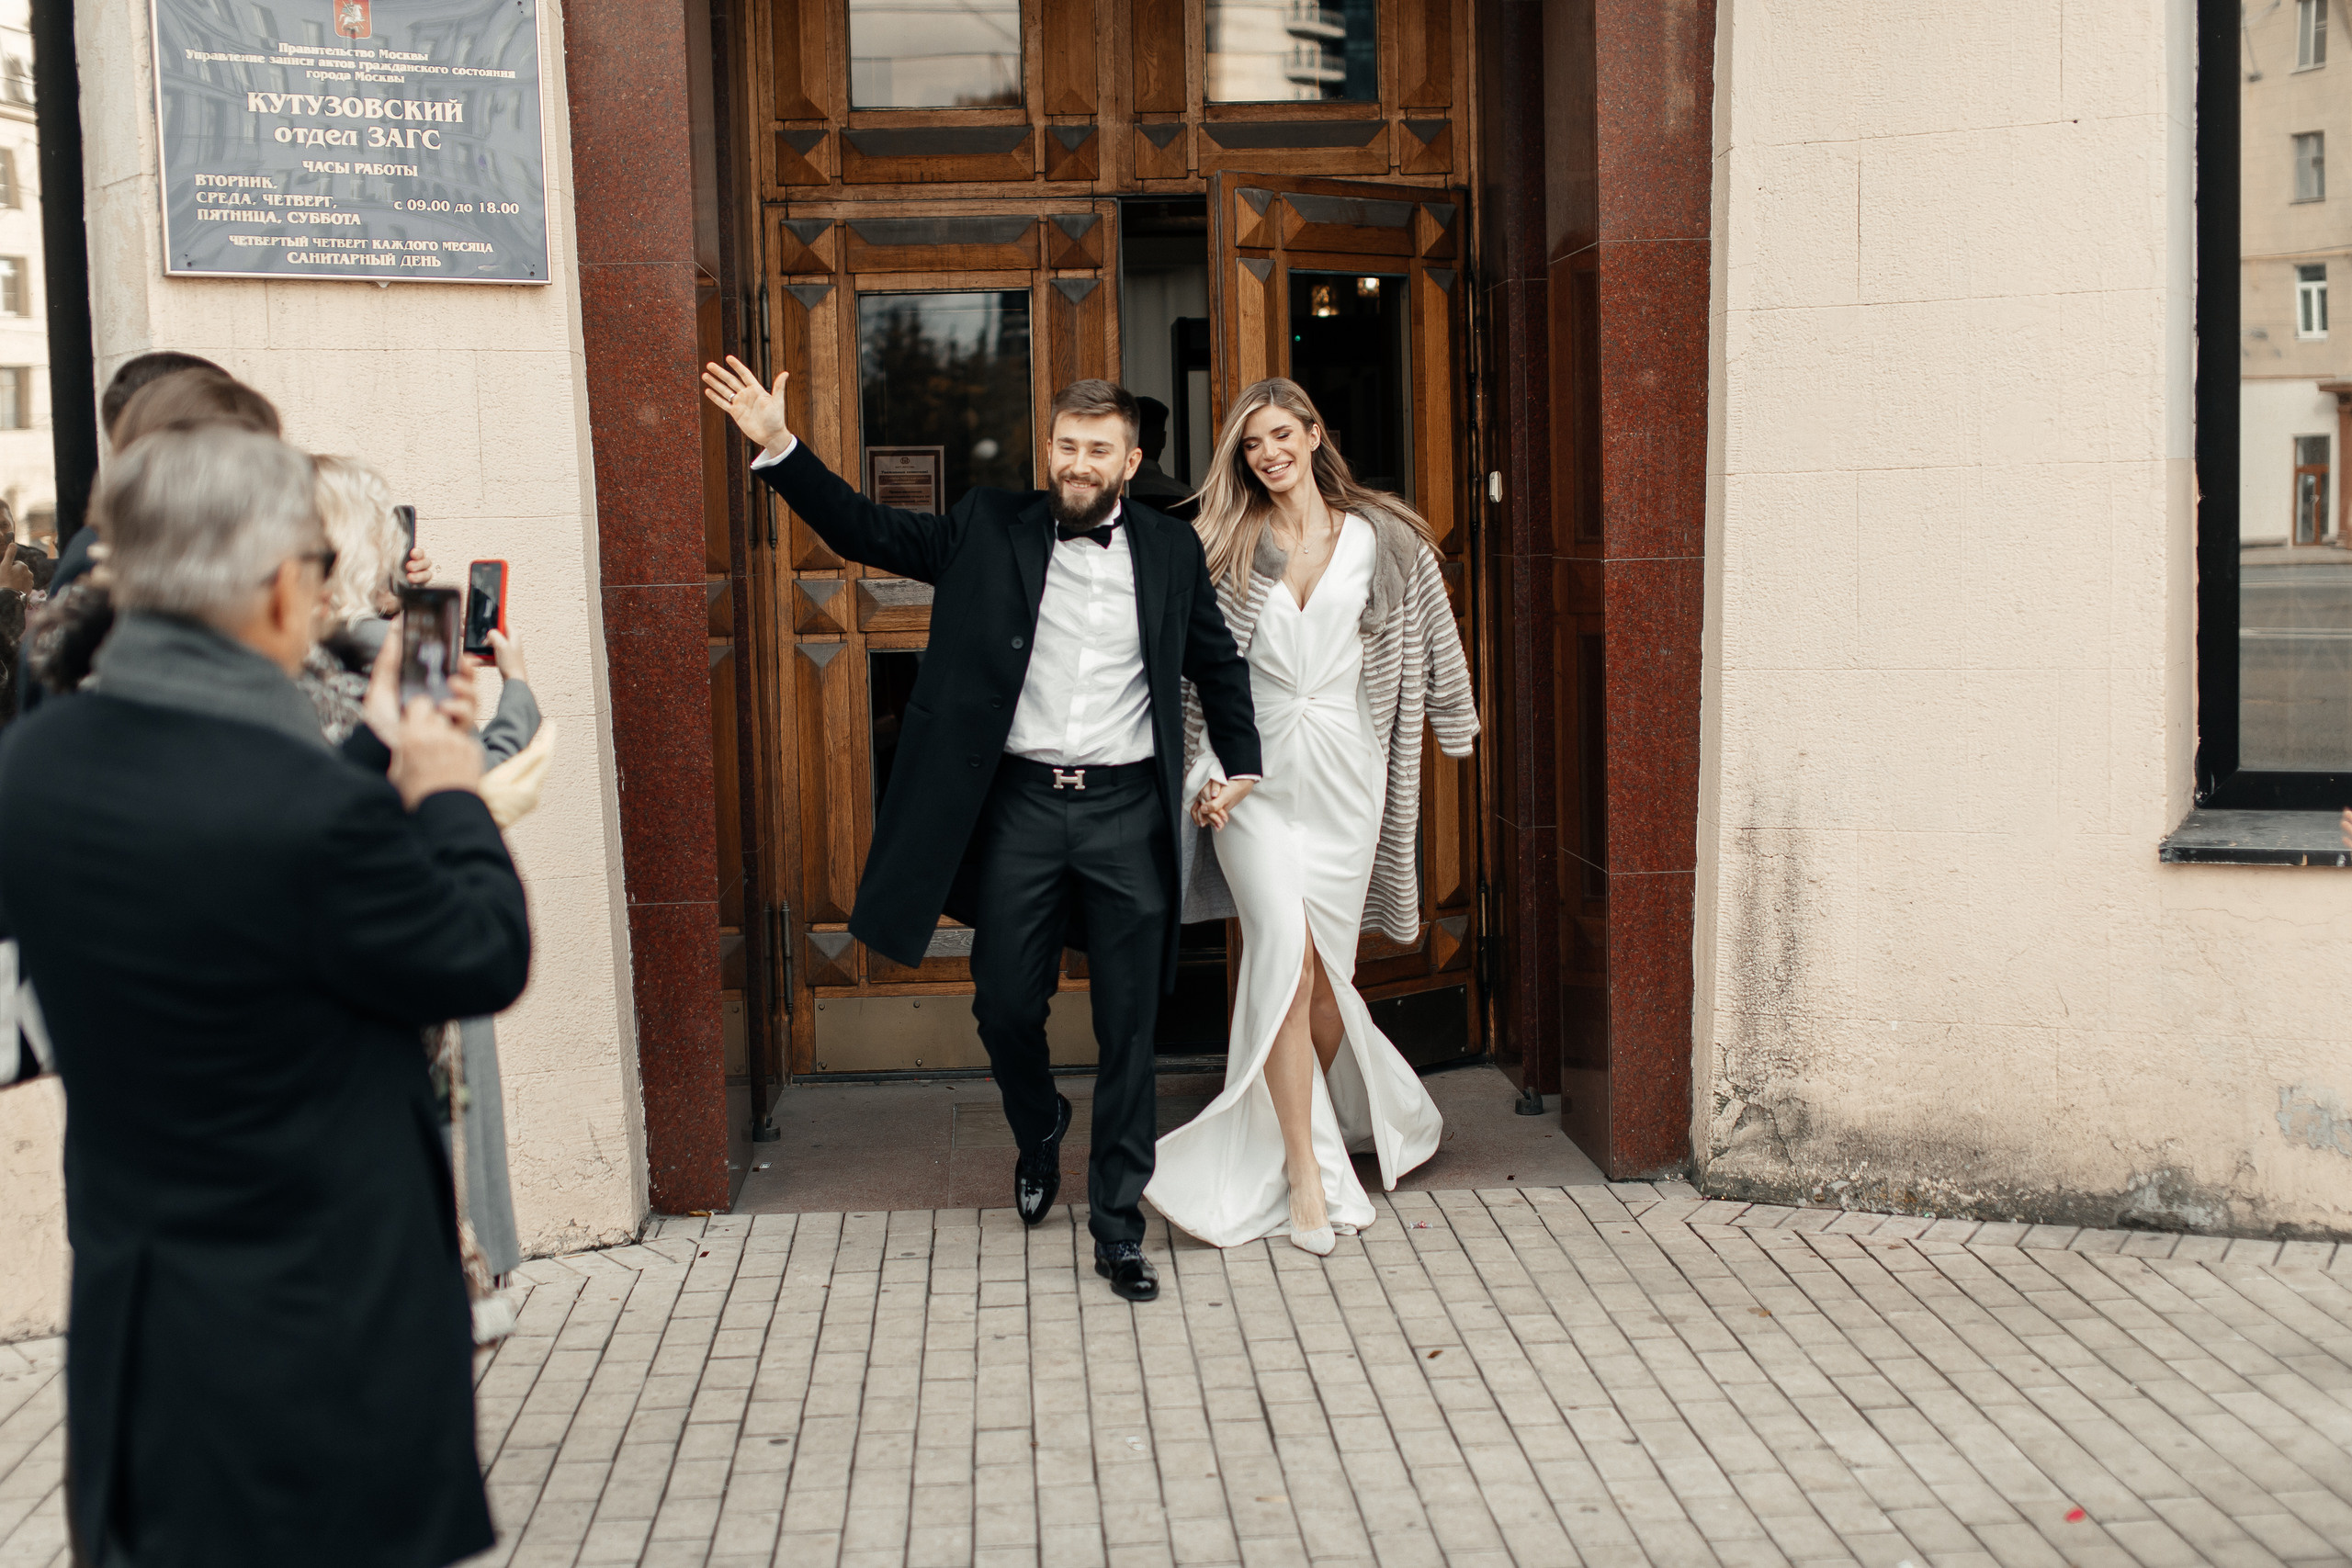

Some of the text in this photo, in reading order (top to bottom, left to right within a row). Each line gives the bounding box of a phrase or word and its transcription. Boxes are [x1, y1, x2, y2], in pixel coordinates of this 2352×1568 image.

[278, 42, 429, 62] Правительство Москвы
[186, 49, 516, 79] Управление записи актов гражданского состояния
[306, 70, 405, 84] города Москвы
[247, 92, 464, 123] КУТУЗОВСКИЙ
[274, 126, 442, 150] отдел ЗАГС
[301, 160, 418, 177] ЧАСЫ РАБОТЫ
[262, 193, 337, 209] ЧЕТВЕРГ,
[406, 198, 450, 212] 09.00
[453, 202, 473, 216] до
[479, 201, 520, 214] 18.00
[287, 211, 361, 225] СУББОТА
[229, 234, 493, 254] ЧЕТВЕРТЫЙ ЧЕТВЕРГ КАЖДОГО МЕСЯЦА
[287, 252, 442, 268] САНИТАРНЫЙ ДЕНЬ
